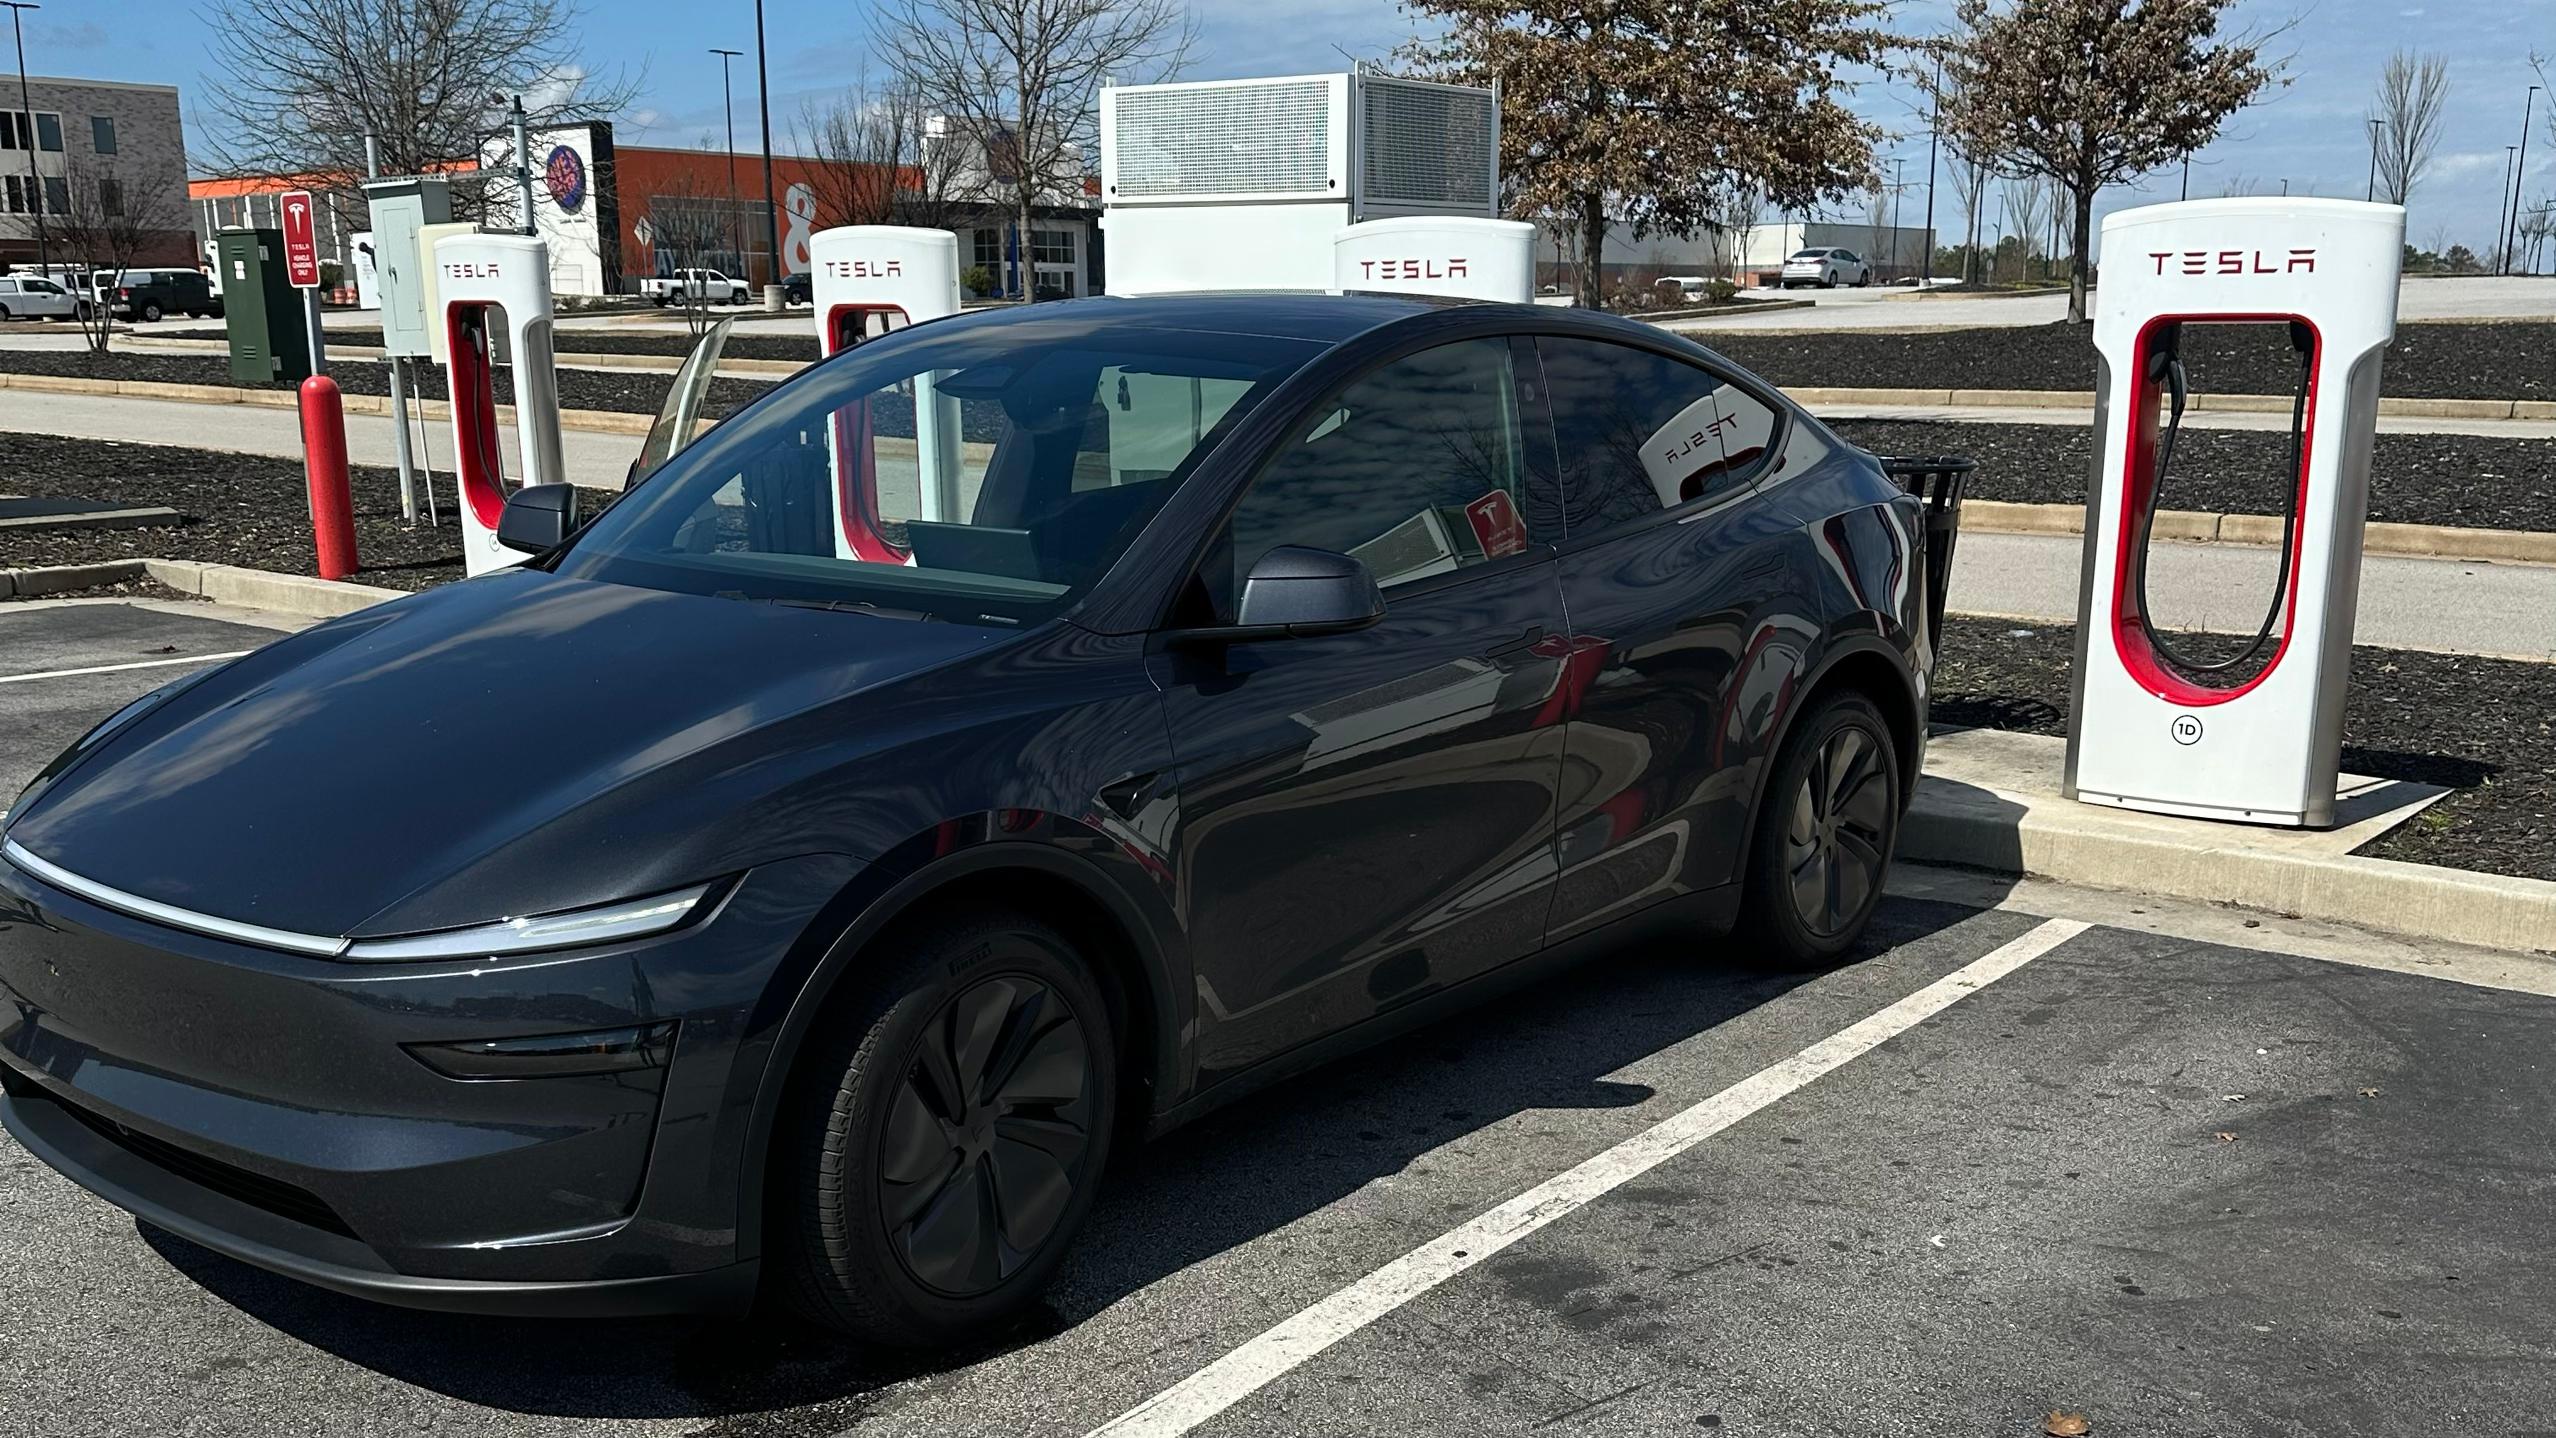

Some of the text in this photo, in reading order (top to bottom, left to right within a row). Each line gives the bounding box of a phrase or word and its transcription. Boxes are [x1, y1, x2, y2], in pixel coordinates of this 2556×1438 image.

[443, 263, 499, 279] TESLA
[825, 260, 901, 278] TESLA
[1360, 258, 1467, 280] TESLA
[2148, 249, 2317, 276] TESLA
[2178, 723, 2196, 736] 1D
